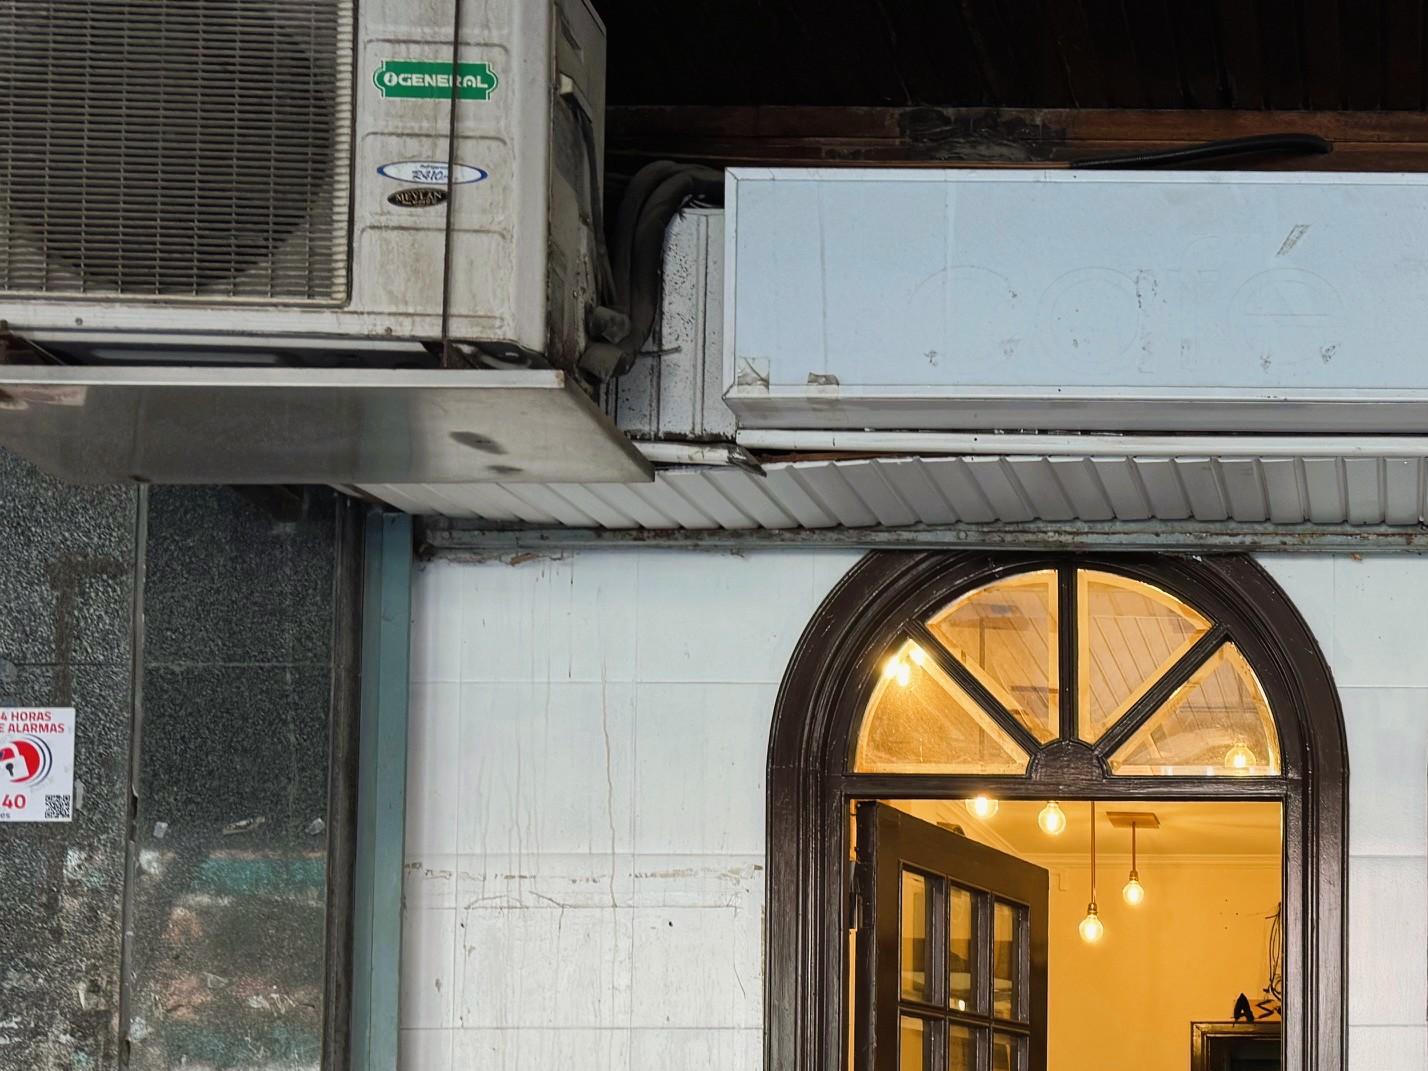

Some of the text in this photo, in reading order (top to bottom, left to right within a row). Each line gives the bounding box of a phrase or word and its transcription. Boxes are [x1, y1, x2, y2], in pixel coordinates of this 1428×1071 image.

[11, 711, 52, 722] HORAS
[8, 722, 65, 734] ALARMAS
[2, 794, 26, 809] 40
